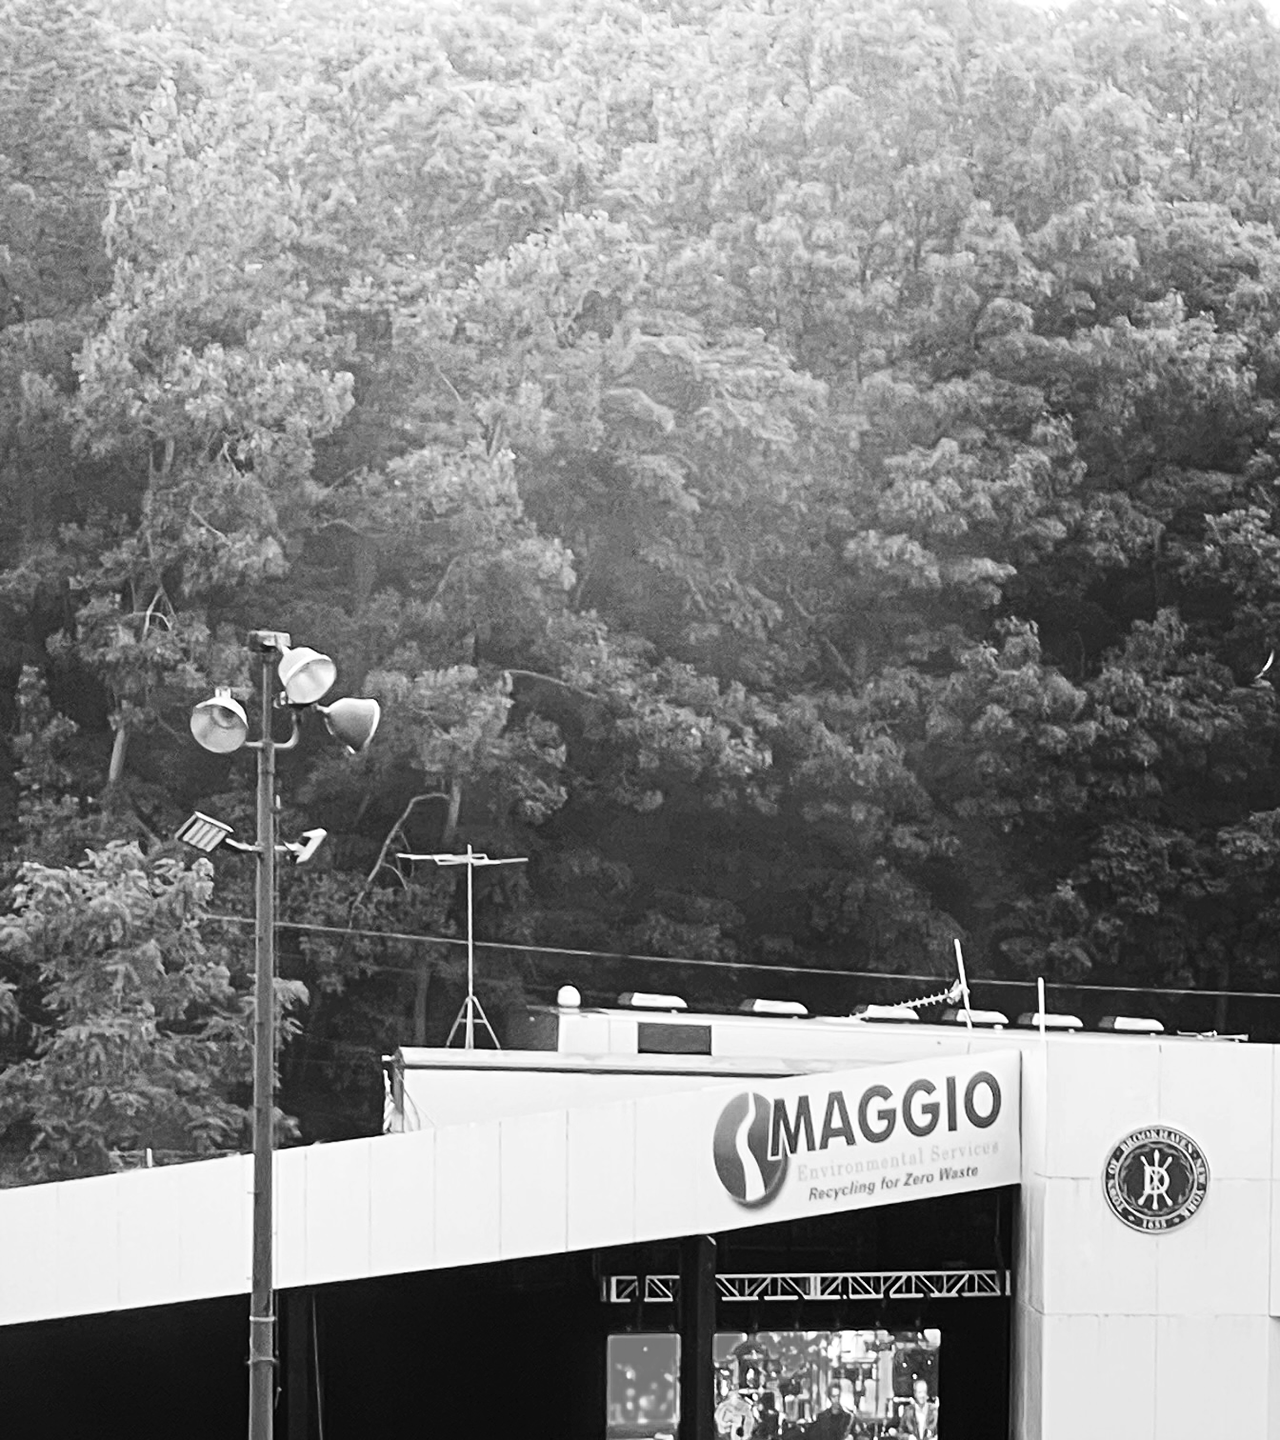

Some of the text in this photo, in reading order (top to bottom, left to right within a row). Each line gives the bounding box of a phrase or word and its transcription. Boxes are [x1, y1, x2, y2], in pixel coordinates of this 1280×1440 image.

[770, 1071, 1002, 1157] MAGGIO
[797, 1141, 1000, 1182] Environmental Services
[808, 1165, 979, 1201] Recycling for Zero Waste
